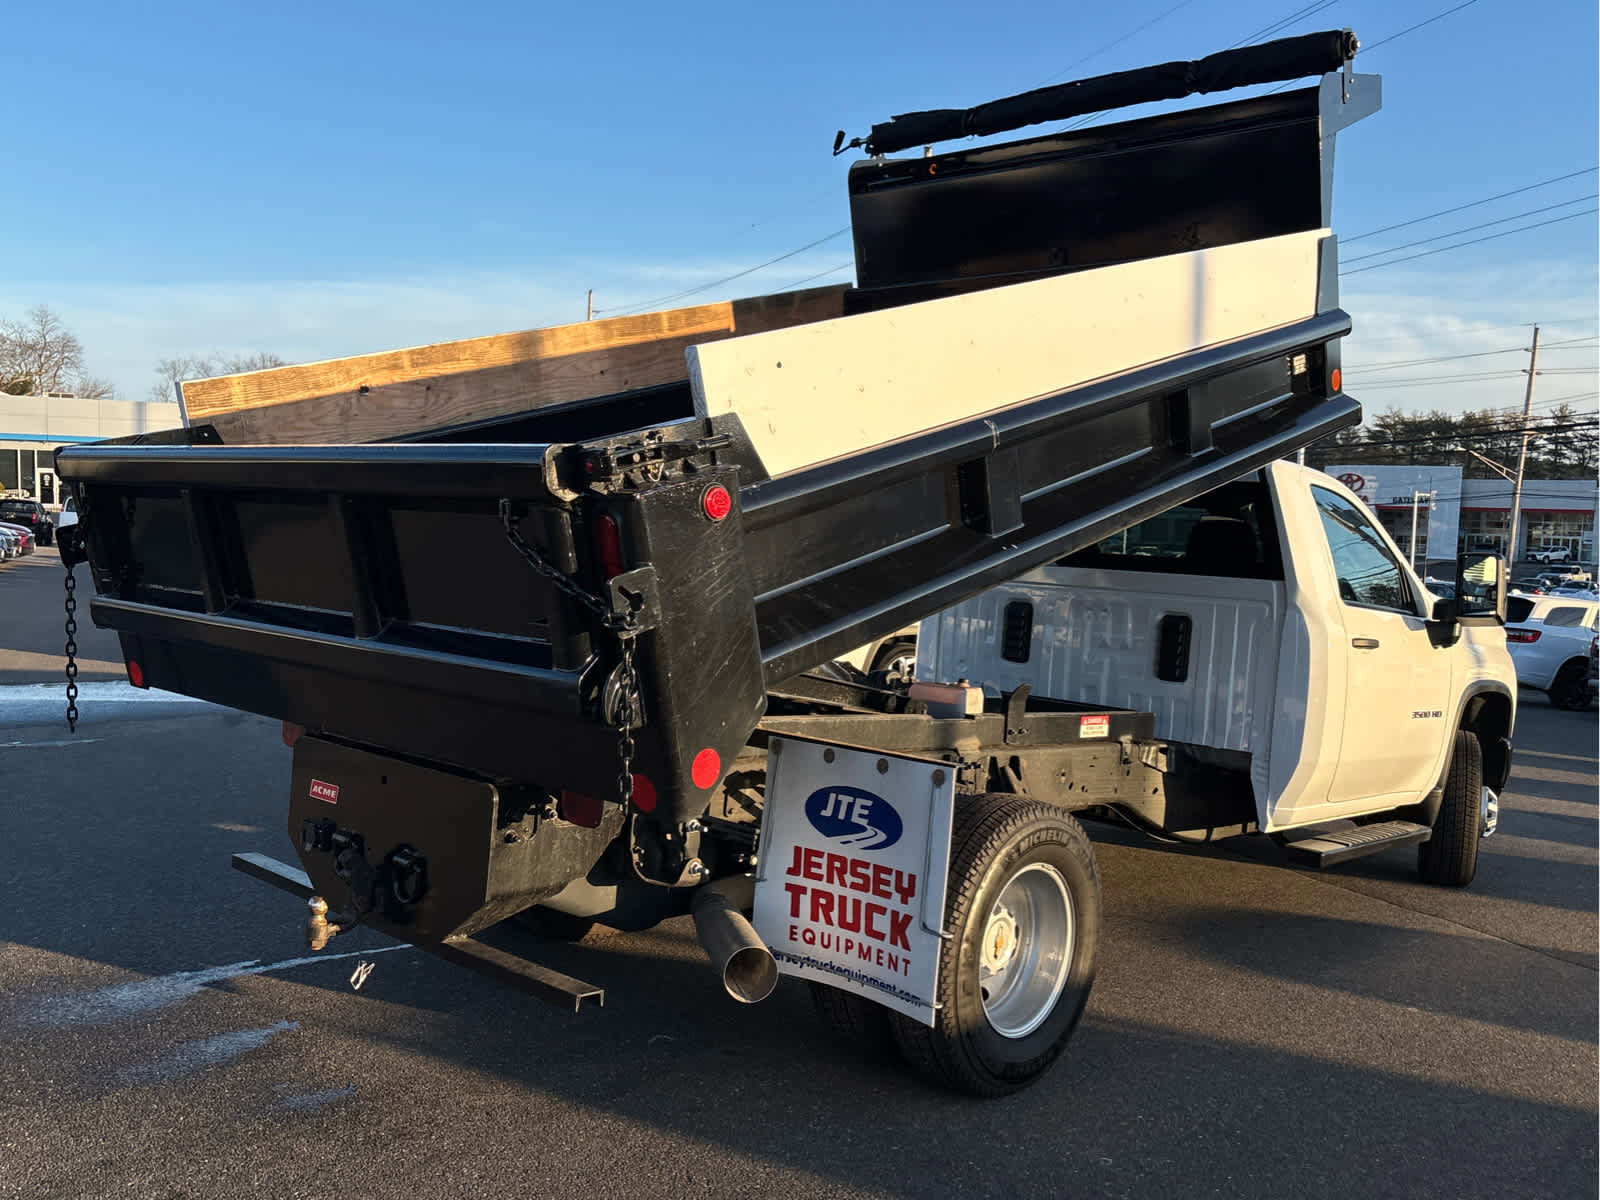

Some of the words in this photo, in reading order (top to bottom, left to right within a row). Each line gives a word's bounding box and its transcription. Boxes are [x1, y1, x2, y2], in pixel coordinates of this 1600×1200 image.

[1411, 711, 1430, 719] 3500
[1432, 710, 1442, 718] HD
[312, 785, 337, 799] ACME
[820, 792, 873, 825] JTE
[1018, 828, 1071, 855] MICHELIN
[785, 845, 916, 905] JERSEY
[784, 882, 913, 951] TRUCK
[789, 925, 911, 976] EQUIPMENT
